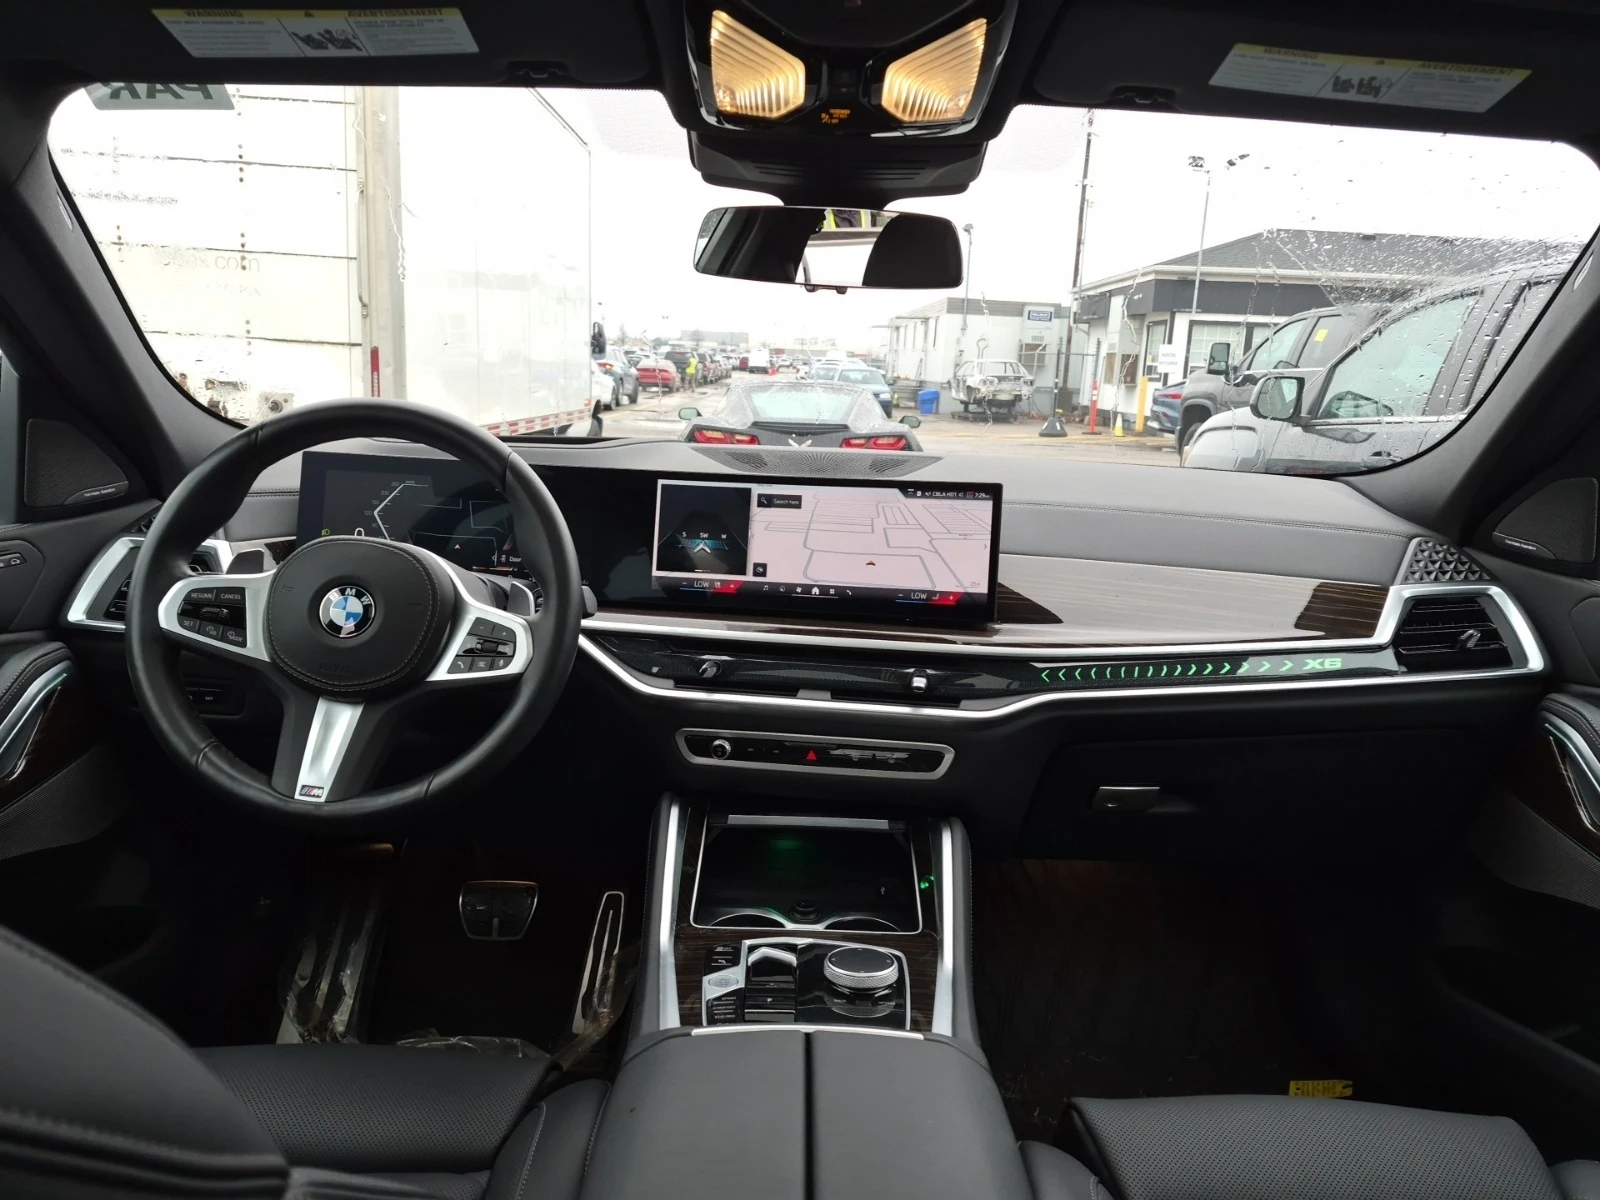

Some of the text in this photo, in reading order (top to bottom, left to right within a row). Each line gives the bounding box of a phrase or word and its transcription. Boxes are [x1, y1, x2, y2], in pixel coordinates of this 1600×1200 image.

[184, 10, 244, 18] WARNING
[348, 8, 444, 17] AVERTISSEMENT
[1263, 47, 1319, 59] WARNING
[694, 580, 710, 588] LOW
[329, 588, 371, 606] BMW
[1302, 657, 1342, 670] X6
